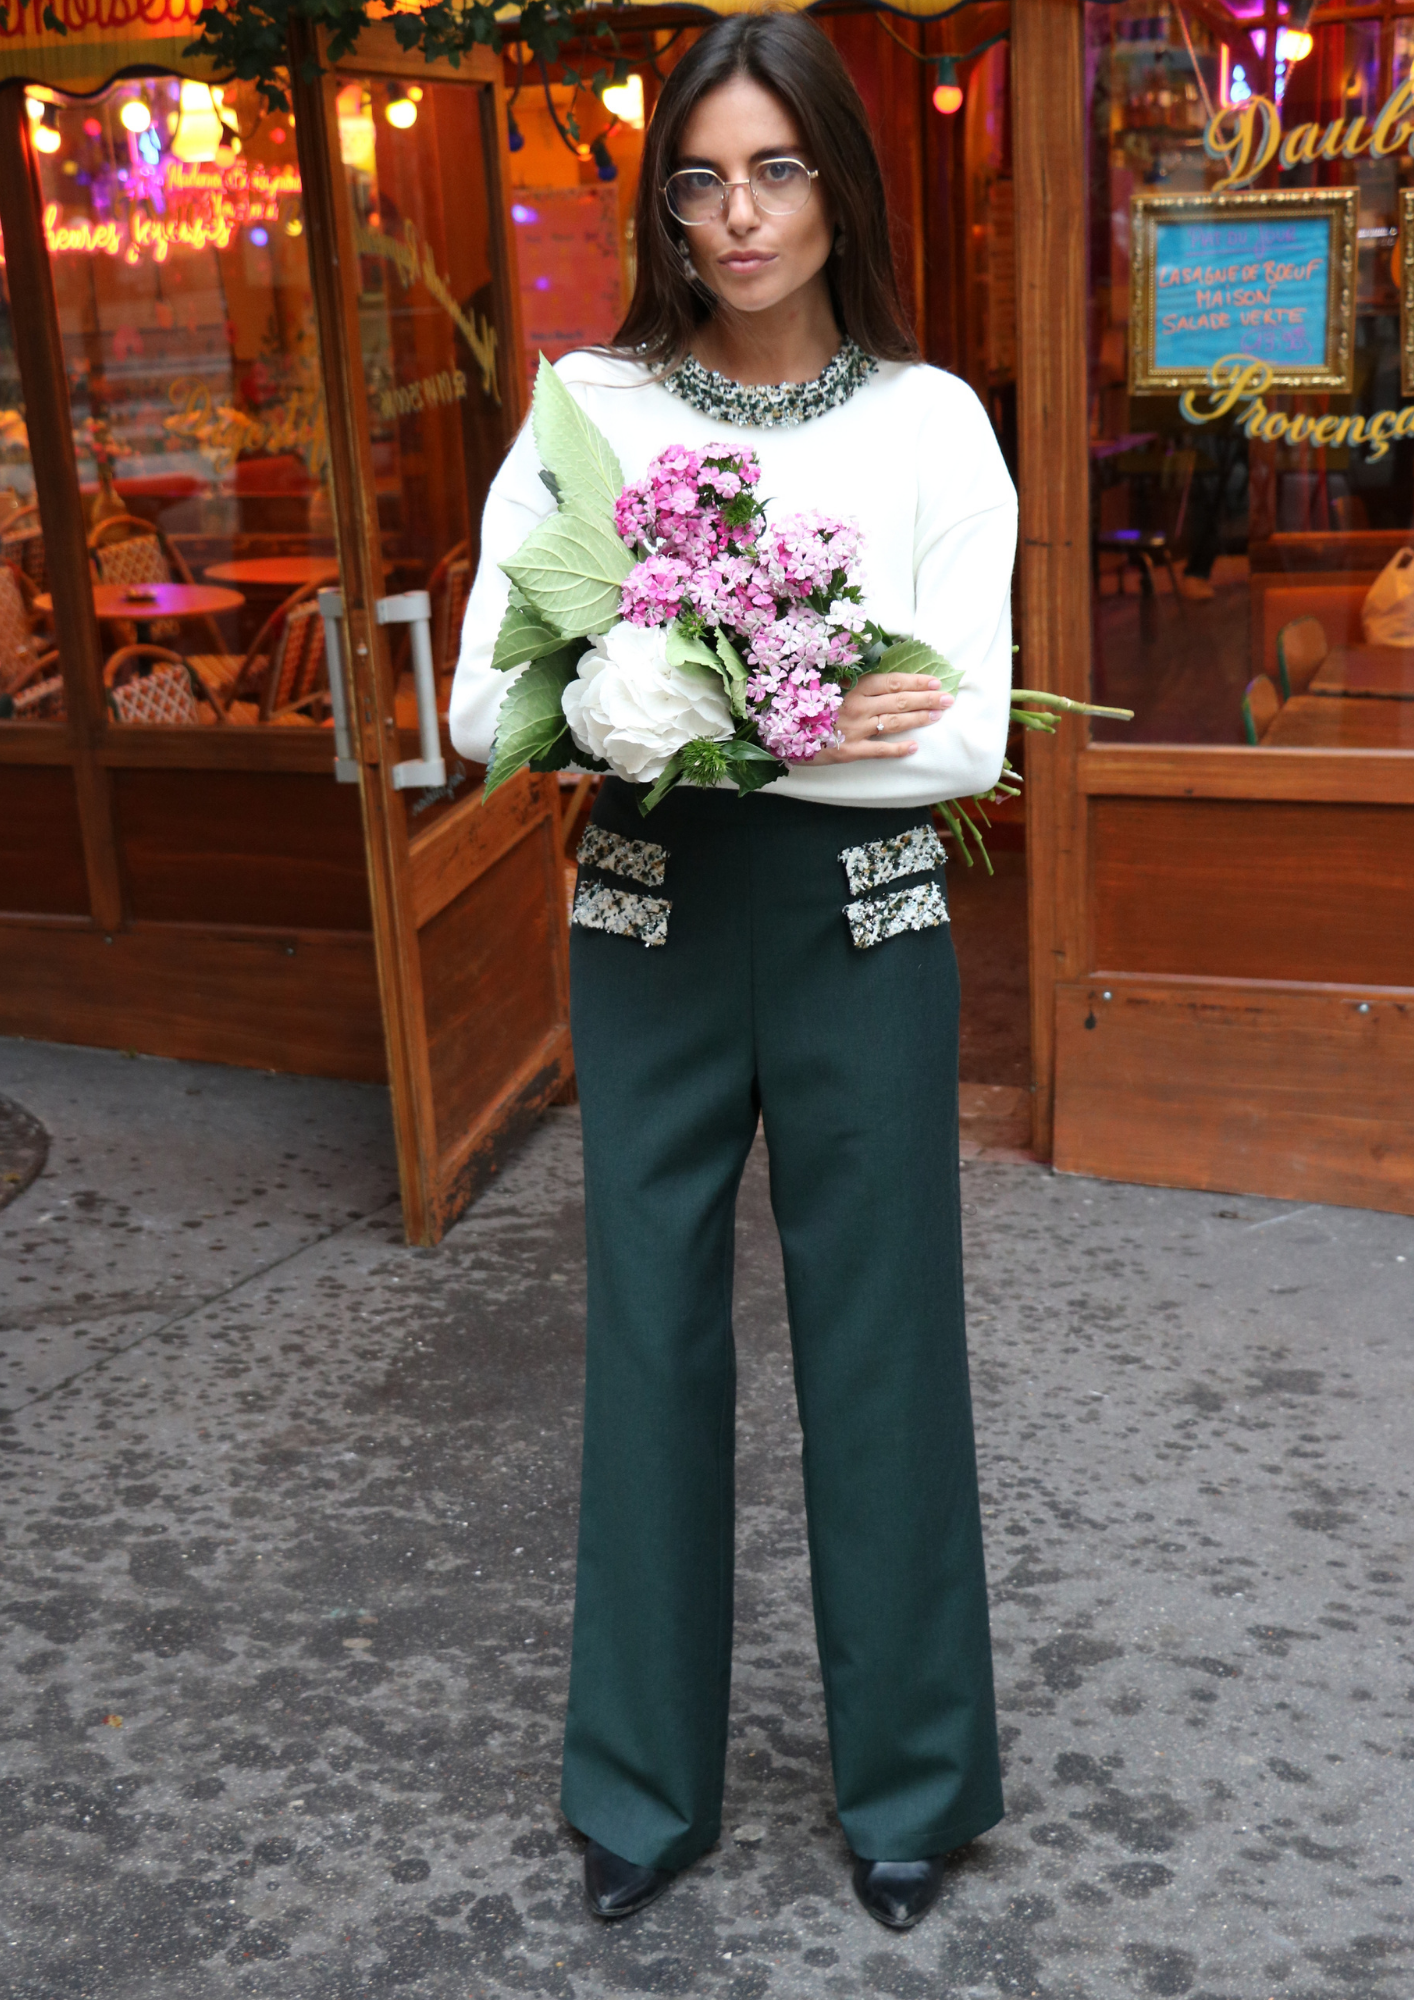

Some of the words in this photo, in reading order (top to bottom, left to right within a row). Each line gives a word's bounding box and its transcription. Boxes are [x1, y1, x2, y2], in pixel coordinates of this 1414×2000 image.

[1227, 230, 1248, 247] DU
[1158, 265, 1239, 288] LASAGNE
[1241, 264, 1260, 282] DE
[1162, 313, 1231, 335] SALADE
[1240, 307, 1307, 326] VERTE
